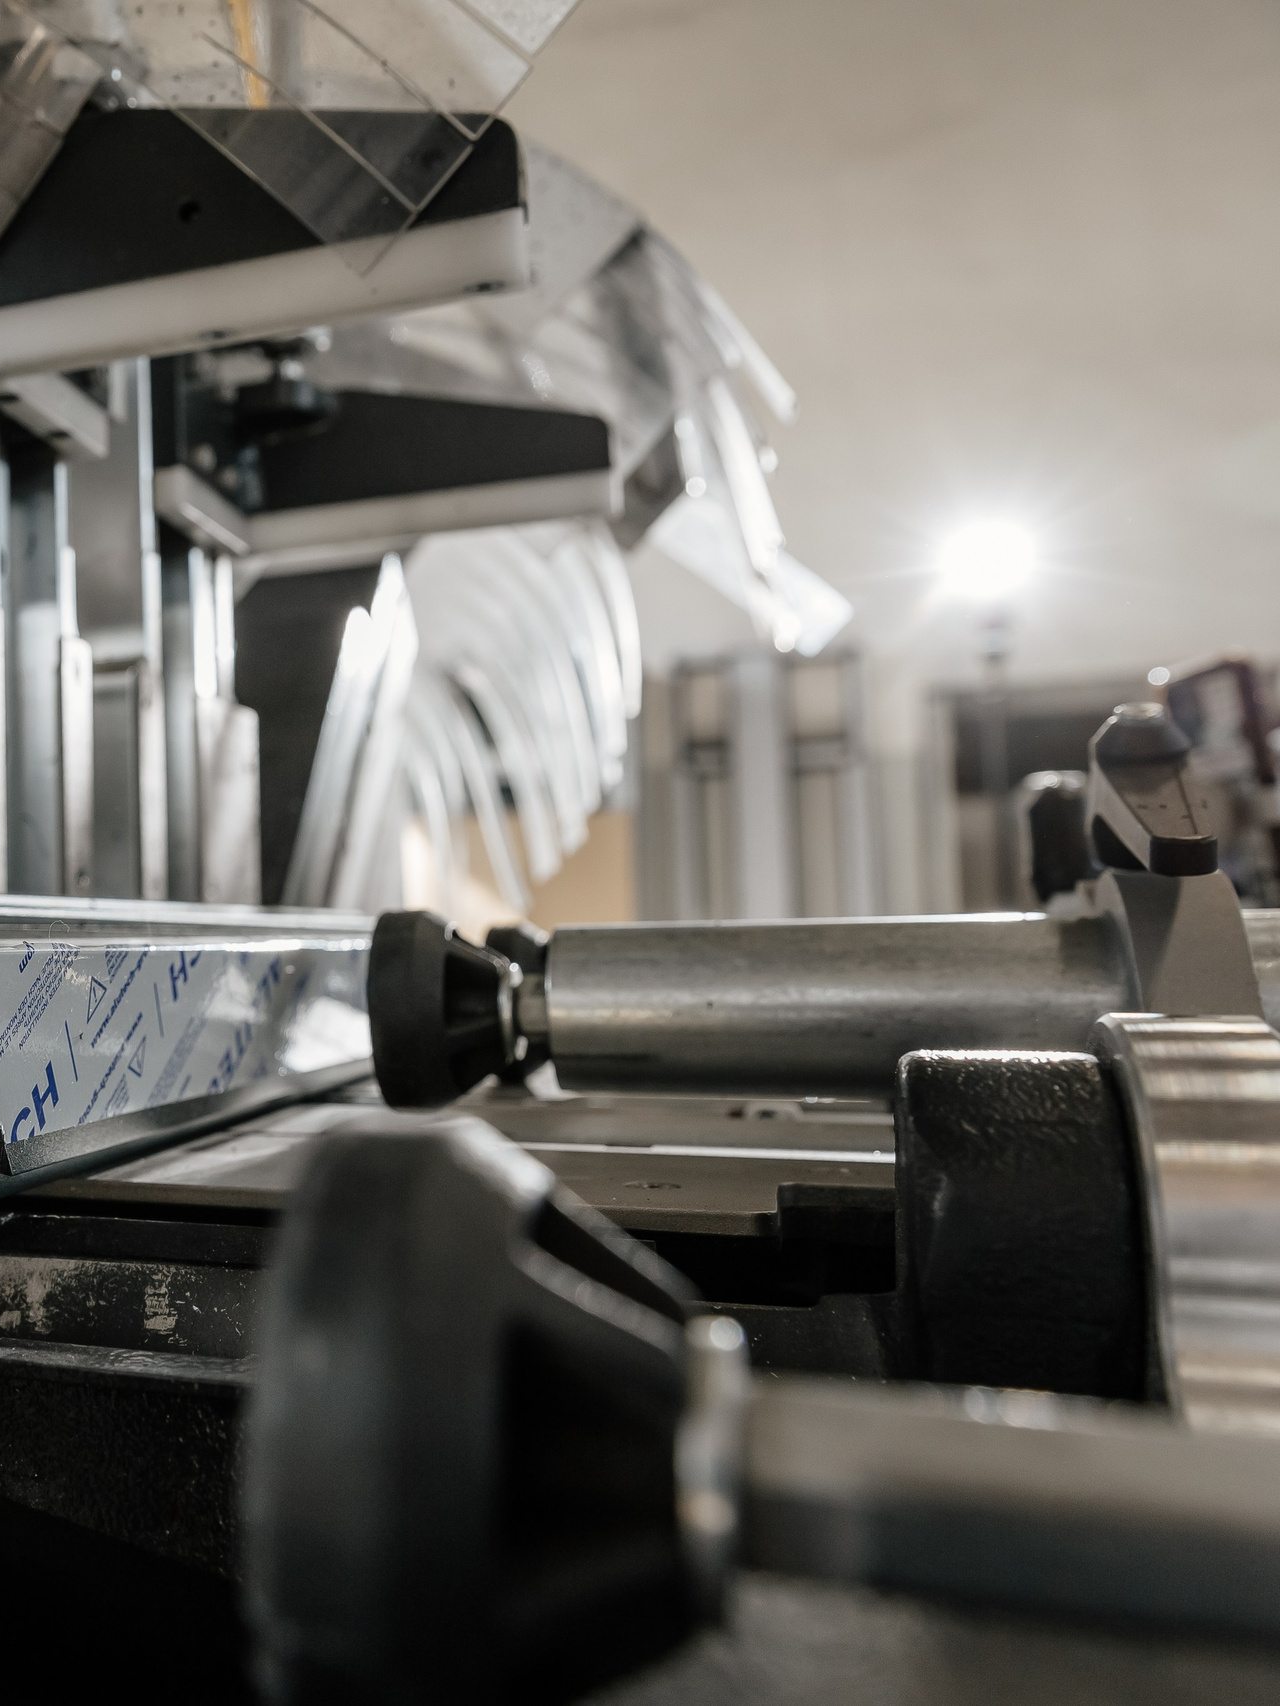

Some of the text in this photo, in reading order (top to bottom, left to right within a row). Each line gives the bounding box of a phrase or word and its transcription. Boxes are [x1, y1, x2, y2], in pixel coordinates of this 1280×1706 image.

[28, 974, 41, 998] NACH
[17, 995, 28, 1015] DER
[18, 998, 49, 1051] INSTALLATION
[4, 1034, 12, 1050] LE
[10, 1060, 59, 1144] CH
